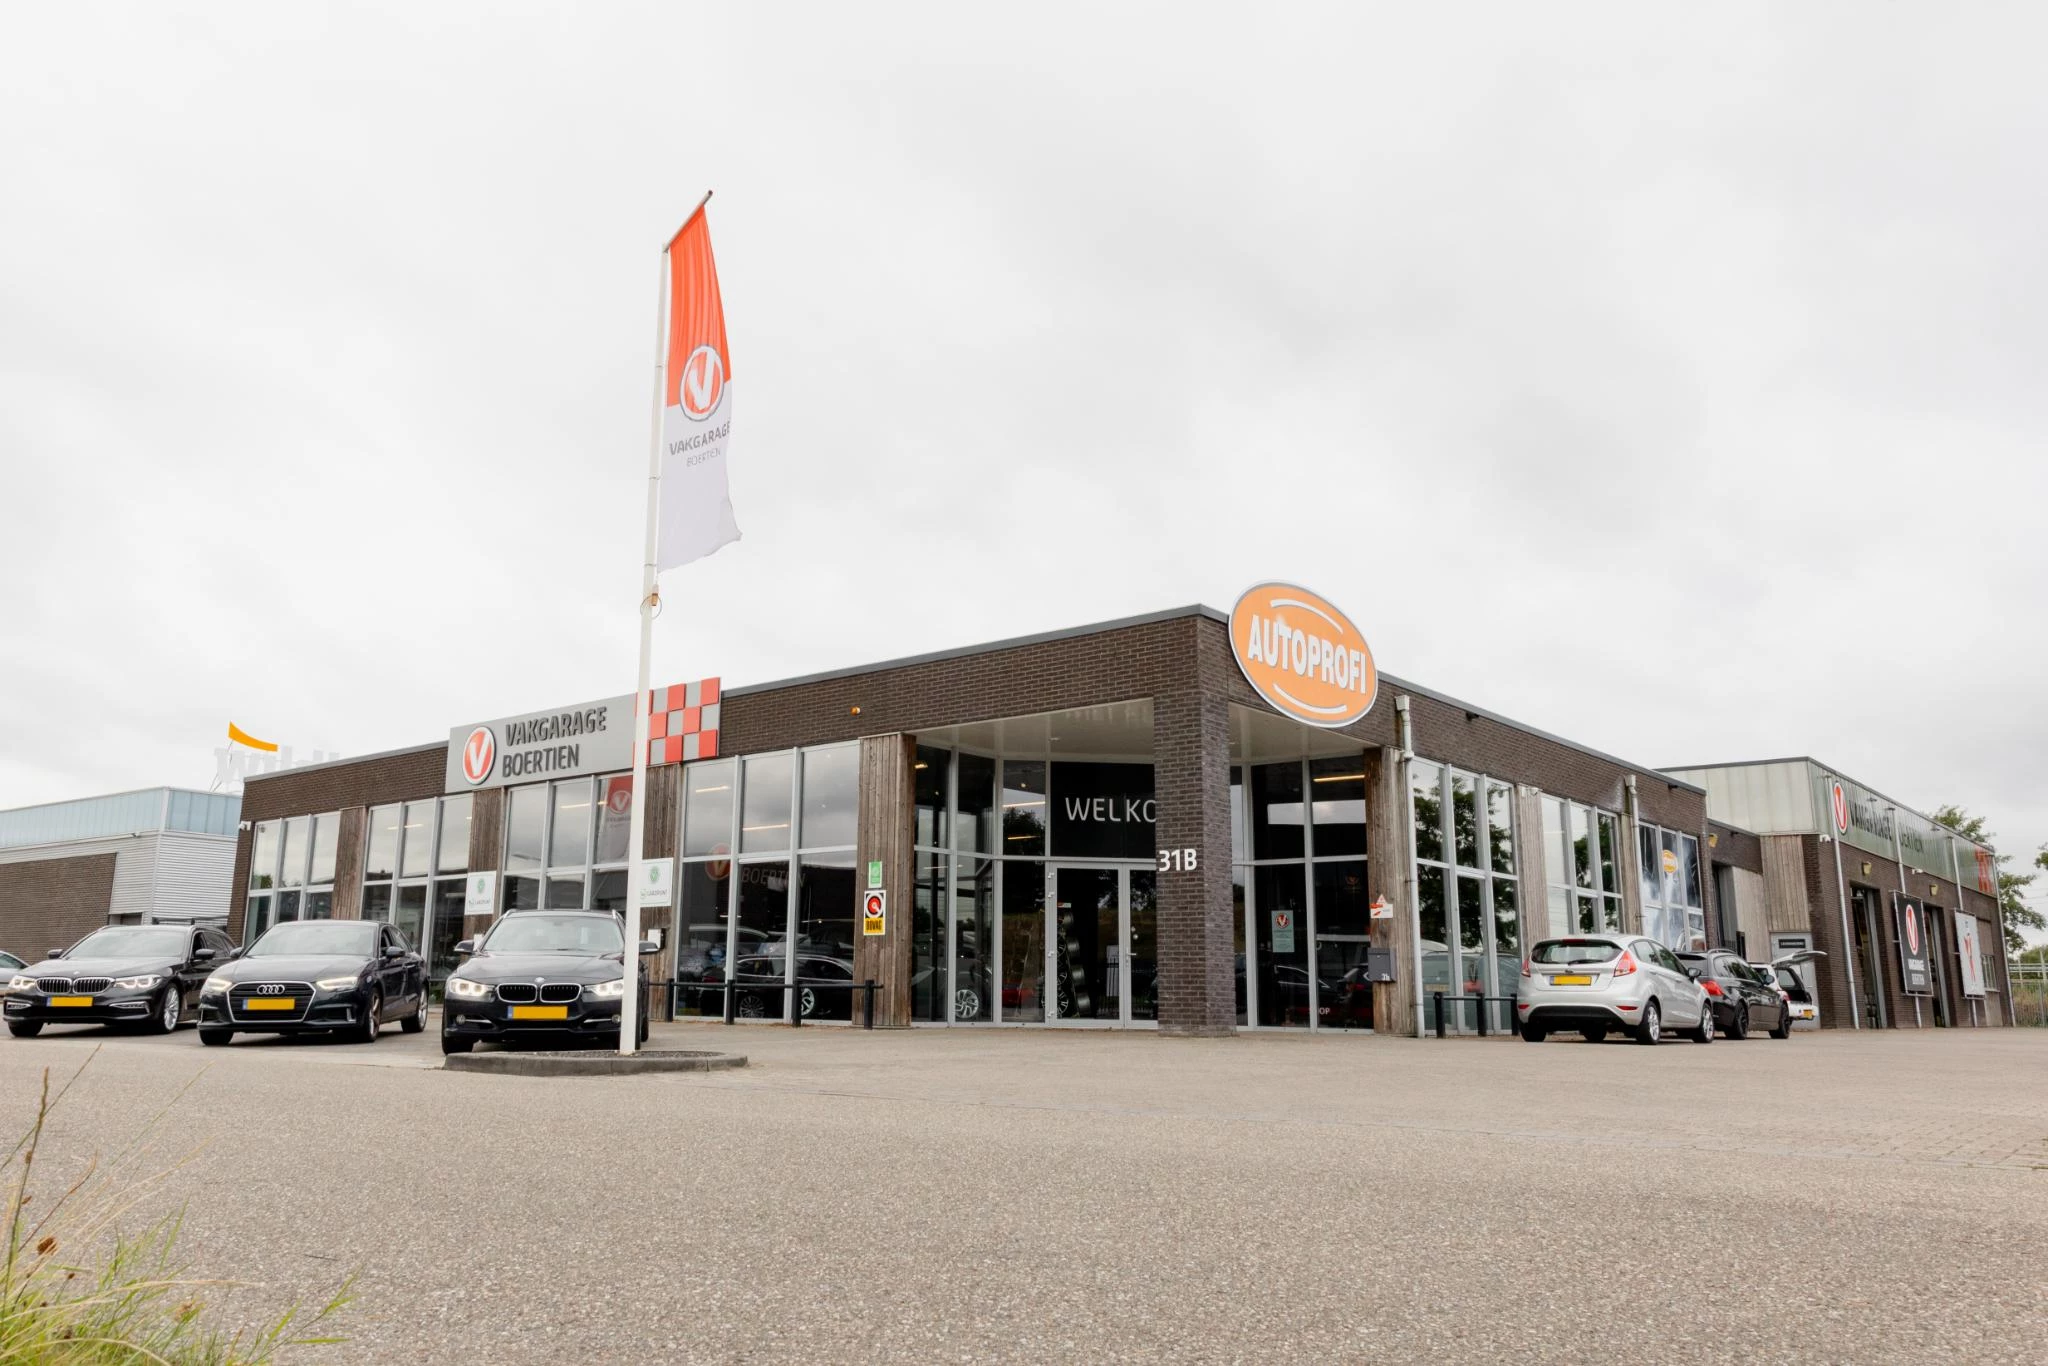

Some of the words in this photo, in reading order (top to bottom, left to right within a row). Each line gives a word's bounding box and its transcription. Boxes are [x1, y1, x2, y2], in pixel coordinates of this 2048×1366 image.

[669, 421, 730, 456] VAKGARAGE
[1247, 614, 1367, 694] AUTOPROFI
[505, 706, 607, 747] VAKGARAGE
[502, 743, 580, 778] BOERTIEN
[1065, 797, 1156, 823] WELKO
[1158, 848, 1198, 872] 31B
